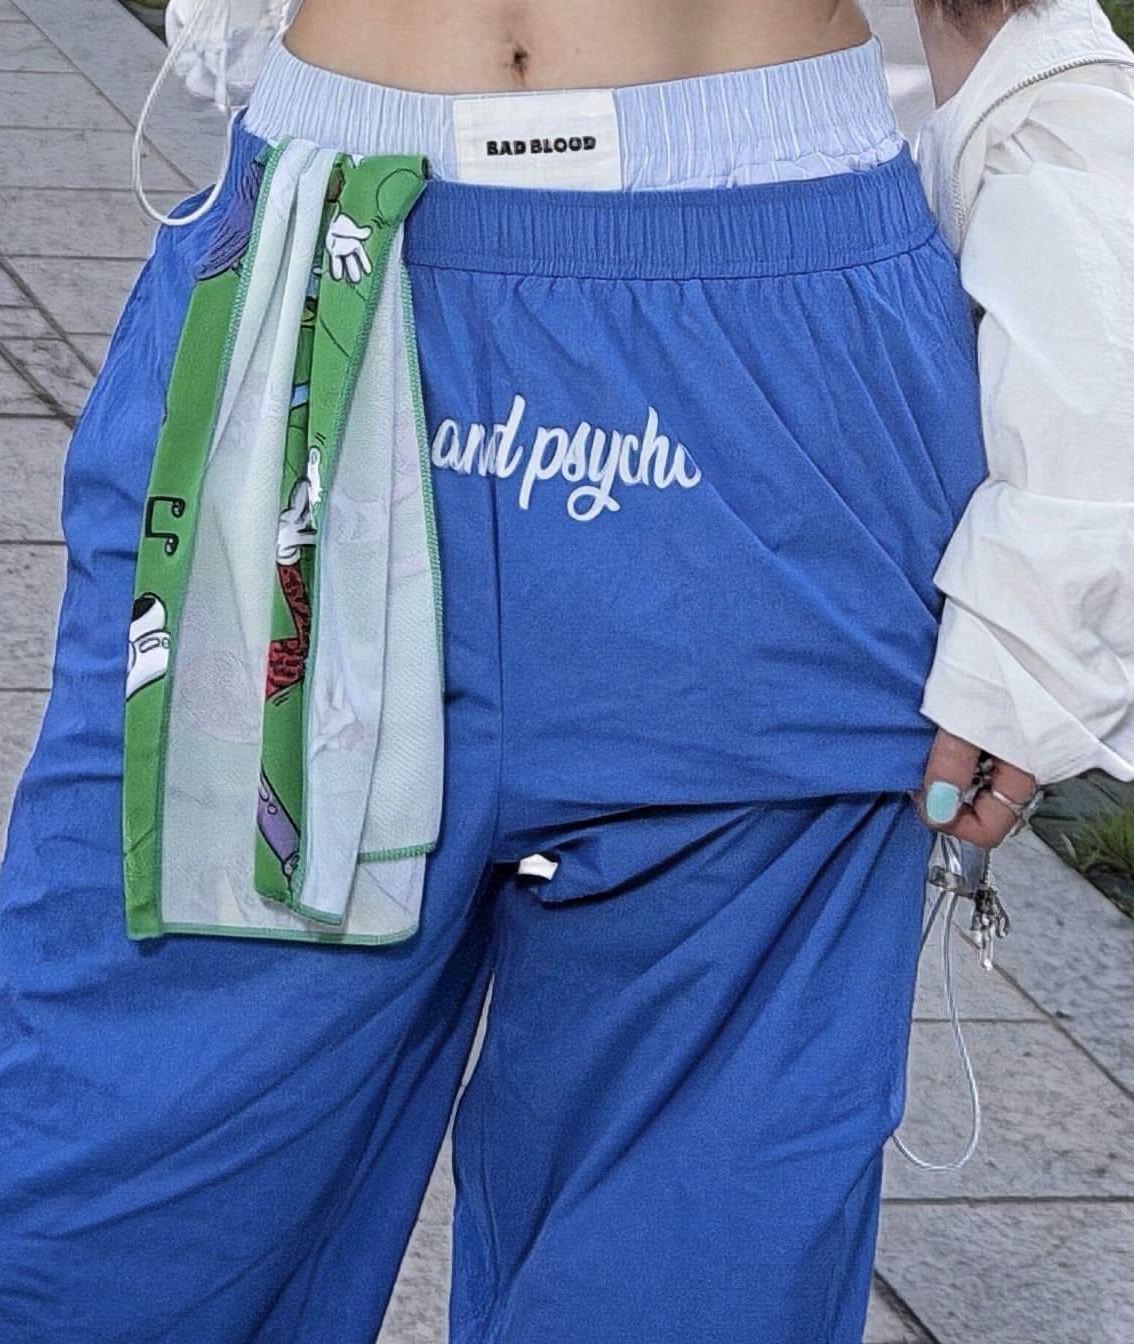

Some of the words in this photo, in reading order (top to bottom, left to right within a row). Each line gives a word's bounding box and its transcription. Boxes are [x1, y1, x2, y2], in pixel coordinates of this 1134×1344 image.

[486, 140, 526, 156] BAD
[530, 136, 597, 154] BLOOD
[431, 394, 527, 479] and
